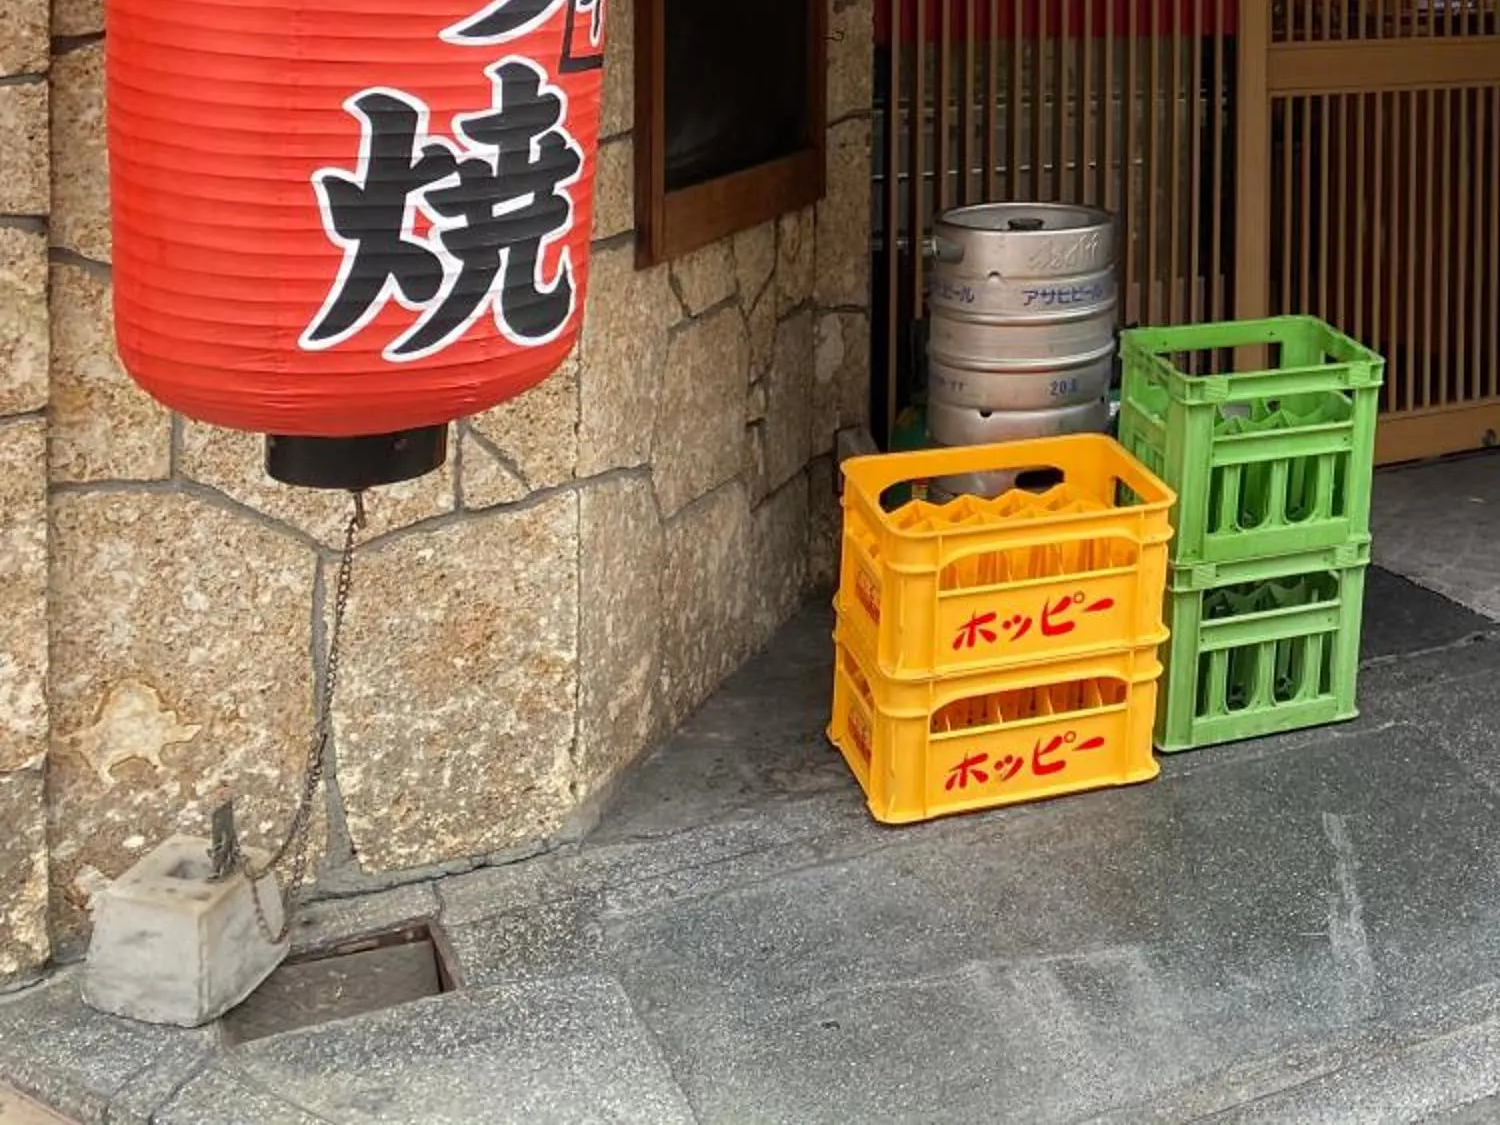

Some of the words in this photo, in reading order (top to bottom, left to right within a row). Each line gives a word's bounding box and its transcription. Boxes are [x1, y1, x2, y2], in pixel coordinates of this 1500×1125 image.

[1023, 284, 1103, 306] アサヒビール
[952, 590, 1115, 651] ホッピー
[945, 730, 1105, 791] ホッピー
